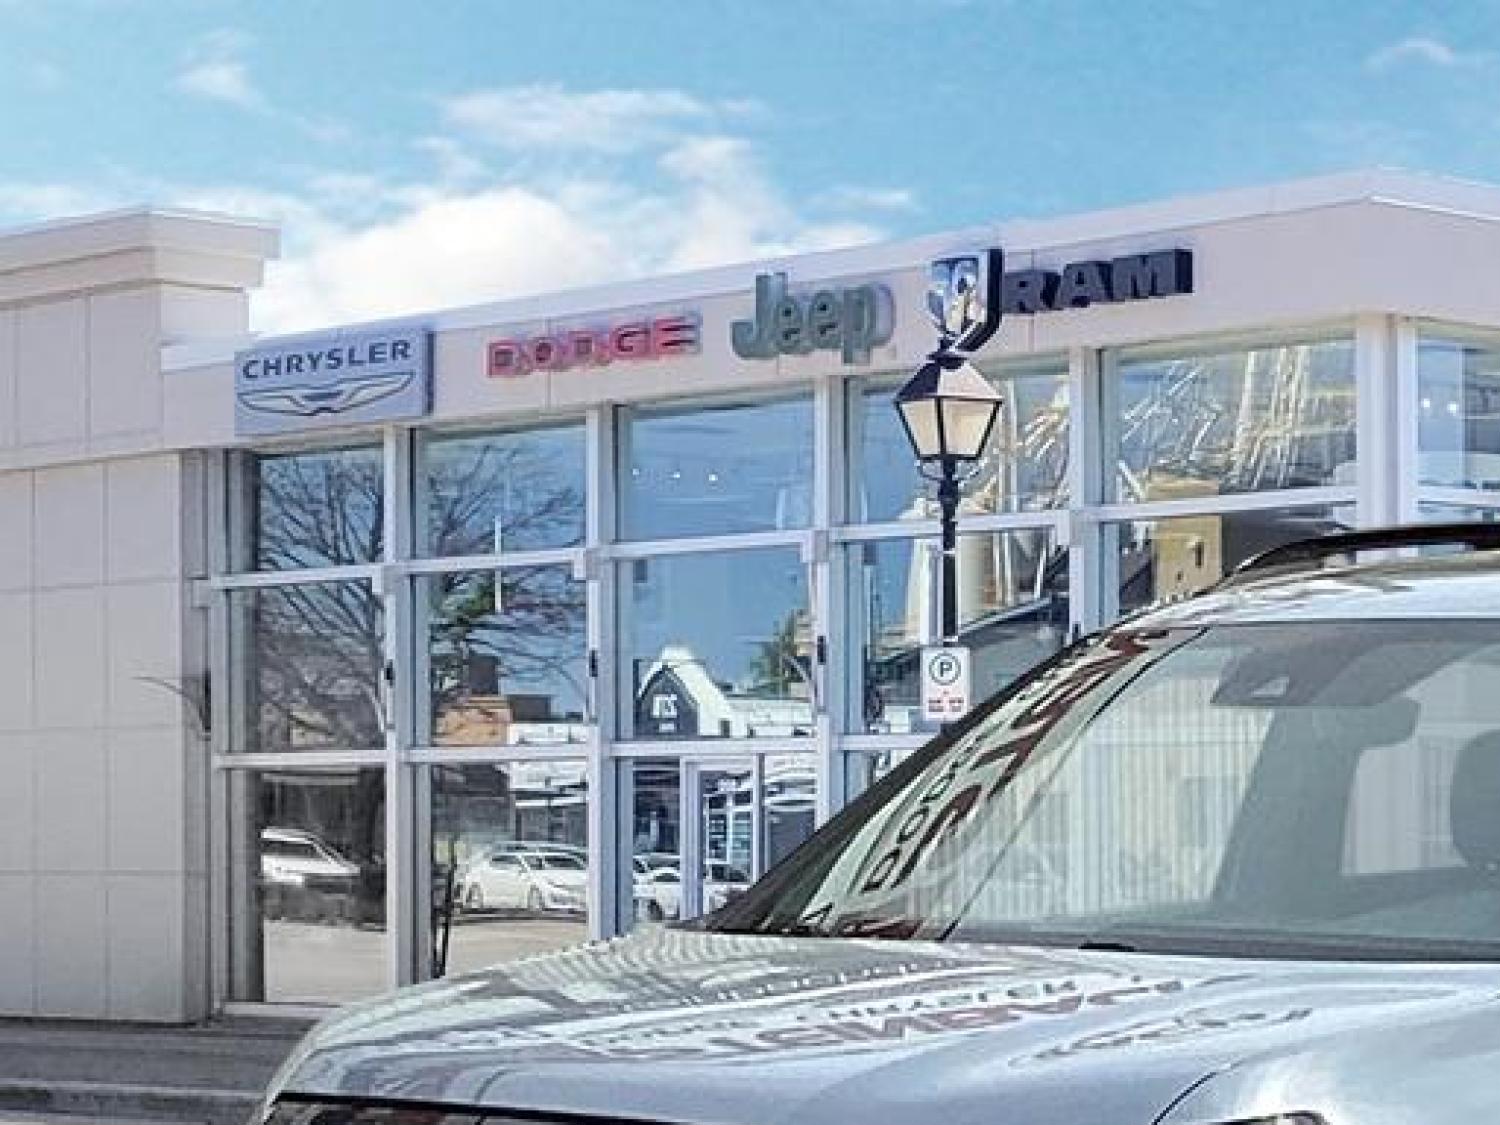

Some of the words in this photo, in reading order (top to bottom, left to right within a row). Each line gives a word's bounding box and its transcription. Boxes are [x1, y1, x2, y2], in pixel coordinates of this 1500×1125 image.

[1002, 248, 1193, 315] RAM
[487, 316, 702, 378] DODGE
[731, 272, 893, 364] Jeep
[242, 339, 411, 380] CHRYSLER
